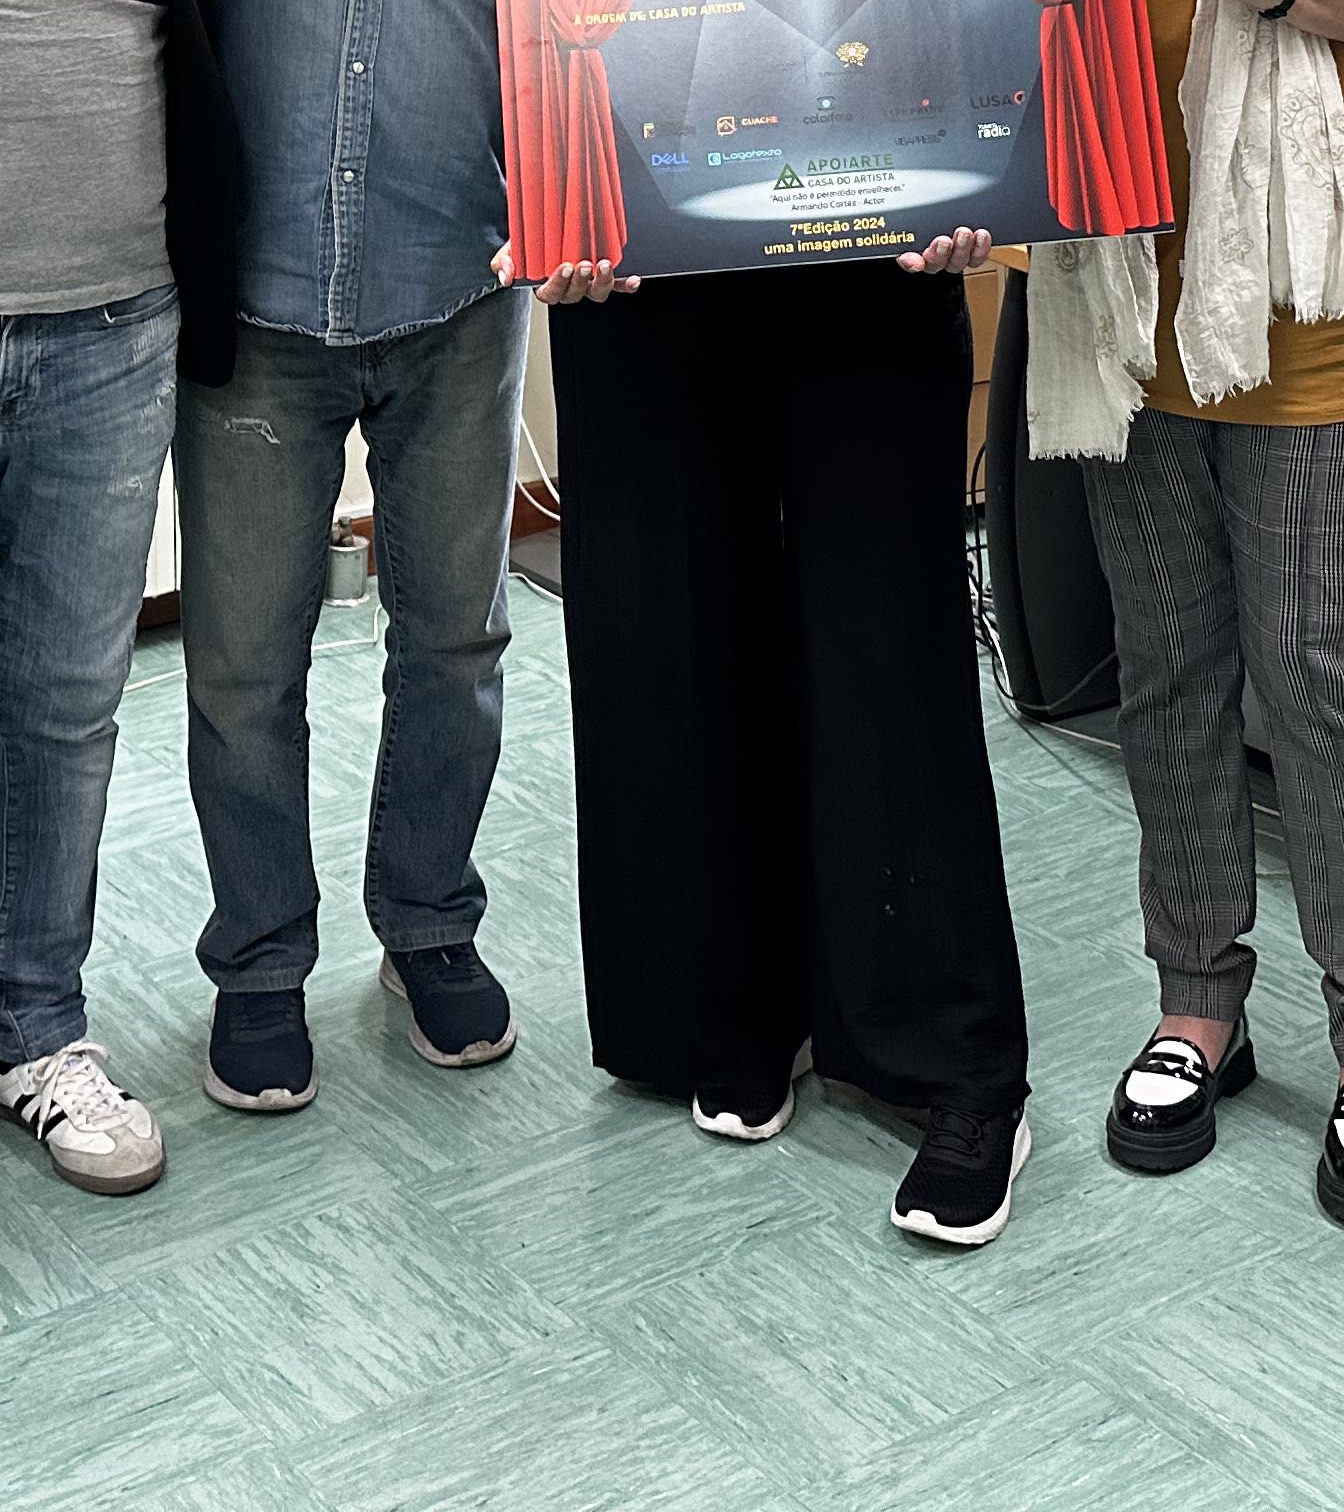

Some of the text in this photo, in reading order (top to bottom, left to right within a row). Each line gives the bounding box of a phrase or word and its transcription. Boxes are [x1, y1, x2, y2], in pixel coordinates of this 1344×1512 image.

[586, 13, 627, 26] ORDEM
[648, 7, 679, 20] CASA
[681, 5, 697, 18] DO
[699, 1, 746, 16] ARTISTA
[969, 93, 1013, 109] LUSA
[651, 151, 689, 167] DELL
[807, 153, 895, 173] APOIARTE
[807, 172, 895, 189] CASA DO ARTISTA
[792, 191, 808, 201] não
[863, 196, 885, 207] Actor
[853, 216, 886, 231] 2024
[764, 230, 916, 256] uma imagem solidária
